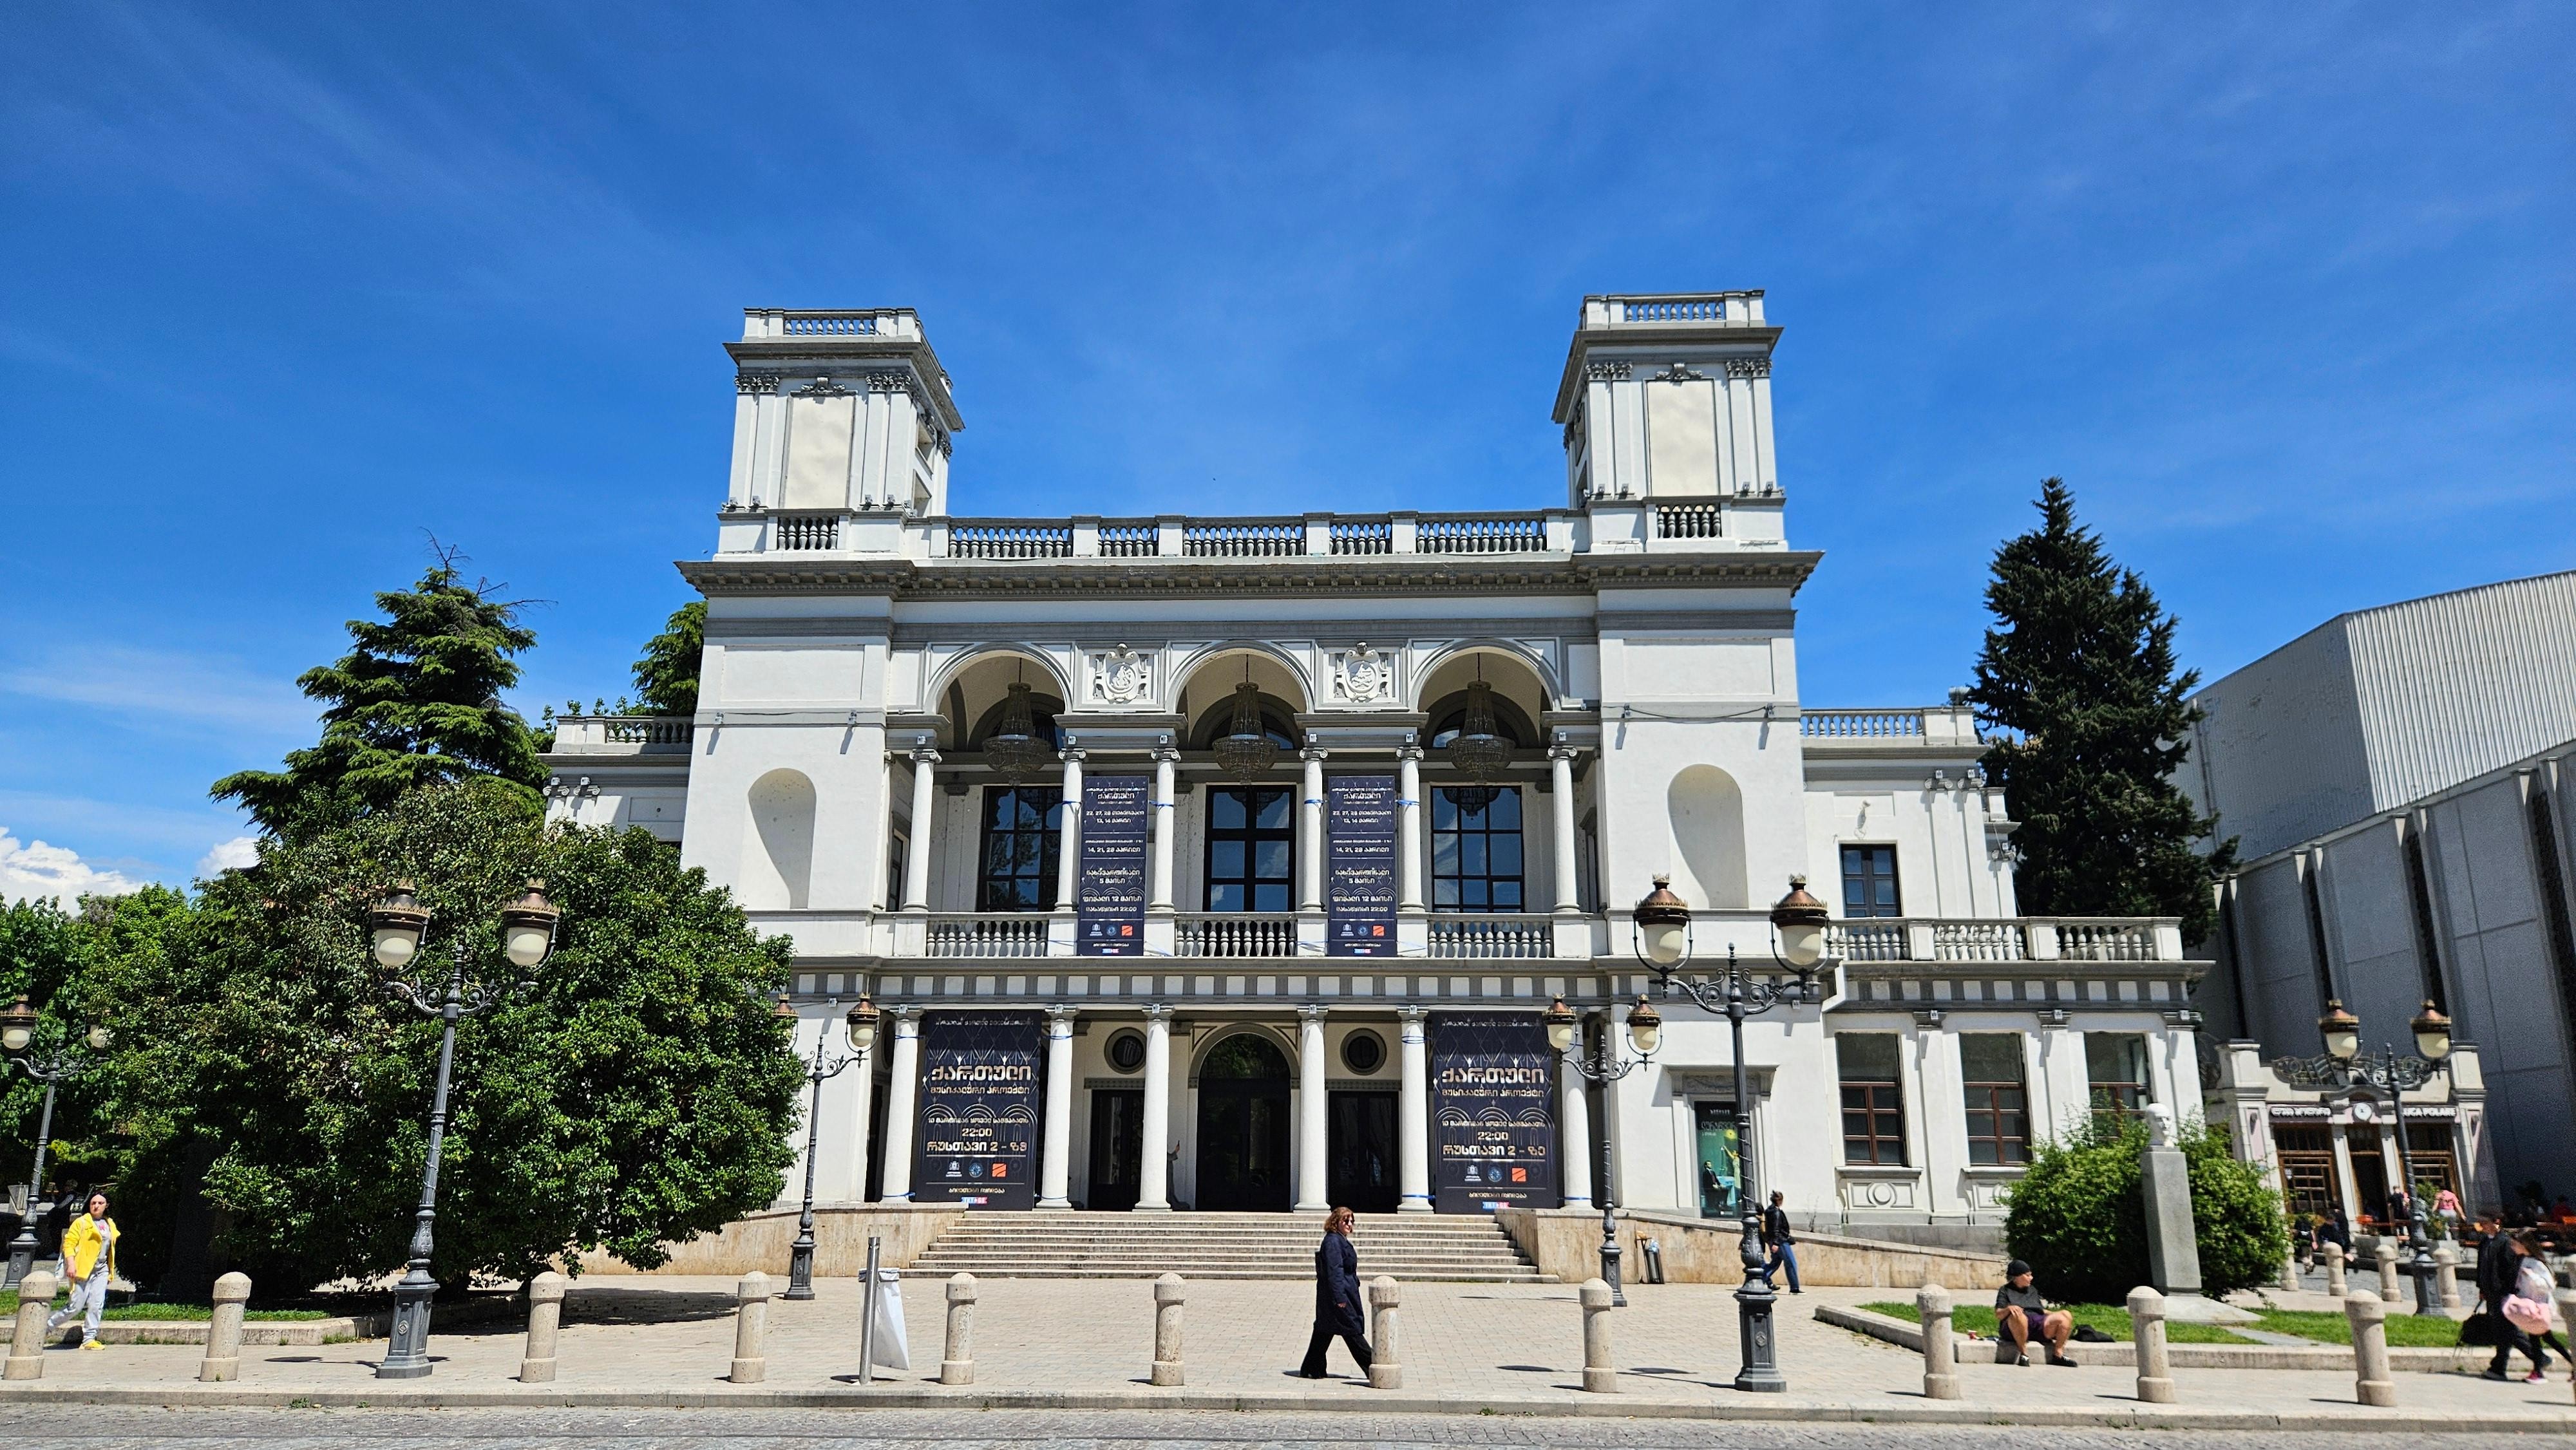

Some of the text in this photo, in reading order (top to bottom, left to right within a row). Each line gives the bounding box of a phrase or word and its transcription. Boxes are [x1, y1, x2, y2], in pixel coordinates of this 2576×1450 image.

[931, 1065, 1031, 1081] ქართული
[1442, 1068, 1545, 1084] ქართული
[2403, 1107, 2457, 1116] UCA POLARE
[961, 1128, 992, 1136] 22:00
[1477, 1131, 1509, 1140] 22:00
[927, 1141, 987, 1151] რუსთავი
[990, 1142, 998, 1151] 2
[1010, 1142, 1027, 1151] ზე
[1443, 1145, 1504, 1155] რუსთავი
[1507, 1145, 1515, 1155] 2
[1528, 1145, 1546, 1156] ზე
